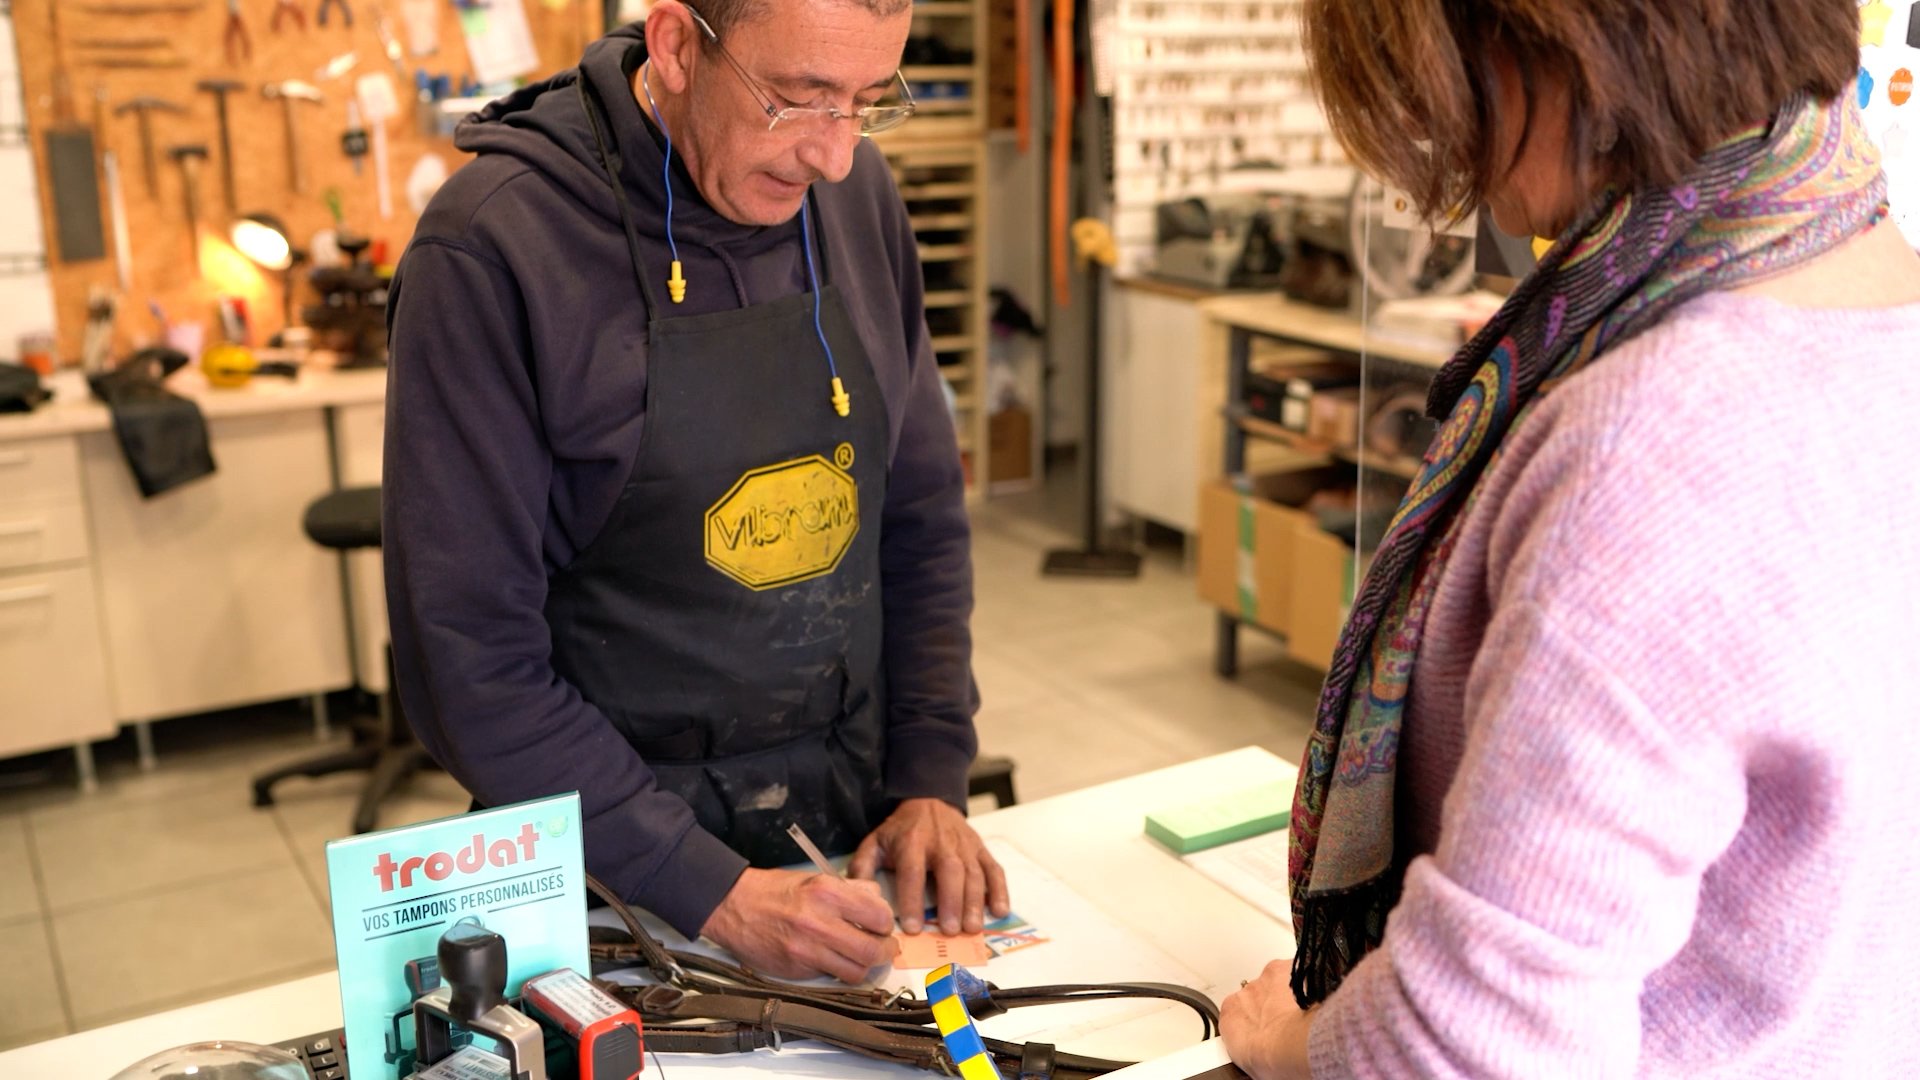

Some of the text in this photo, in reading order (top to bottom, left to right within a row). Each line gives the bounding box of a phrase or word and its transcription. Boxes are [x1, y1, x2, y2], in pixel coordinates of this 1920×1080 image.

[373, 823, 540, 892] trodat
[363, 874, 564, 932] VOS TAMPONS PERSONNALISÉS
